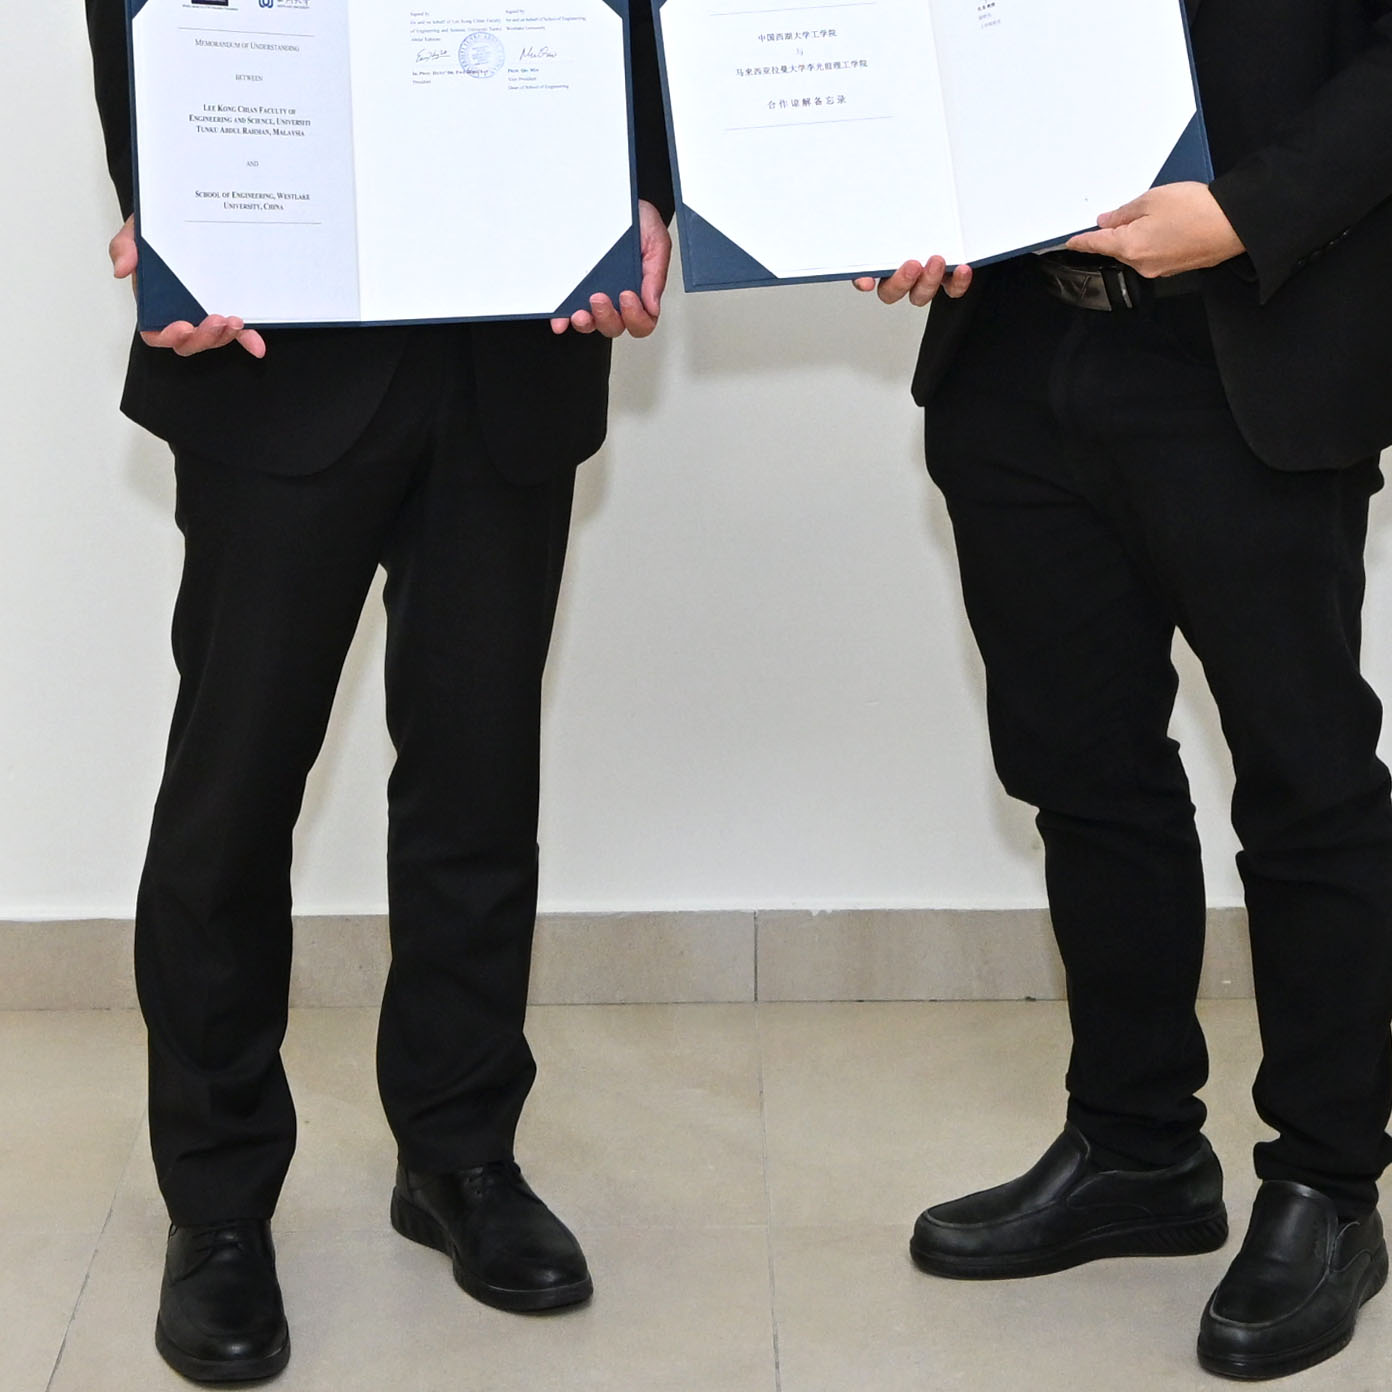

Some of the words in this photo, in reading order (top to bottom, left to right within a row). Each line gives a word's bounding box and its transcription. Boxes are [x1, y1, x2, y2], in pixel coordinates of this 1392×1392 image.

[250, 42, 300, 52] UNDERSTANDING
[203, 104, 216, 112] LEE
[217, 104, 236, 112] KONG
[237, 105, 258, 114] CHIAN
[259, 106, 287, 114] FACULTY
[189, 115, 233, 124] ENGINEERING
[247, 117, 275, 125] SCIENCE,
[276, 117, 311, 126] UNIVERSITI
[196, 125, 219, 134] TUNKU
[220, 126, 241, 134] ABDUL
[242, 127, 272, 136] RAHMAN,
[273, 128, 305, 136] MALAYSIA
[231, 192, 275, 200] ENGINEERING,
[223, 202, 262, 210] UNIVERSITY,
